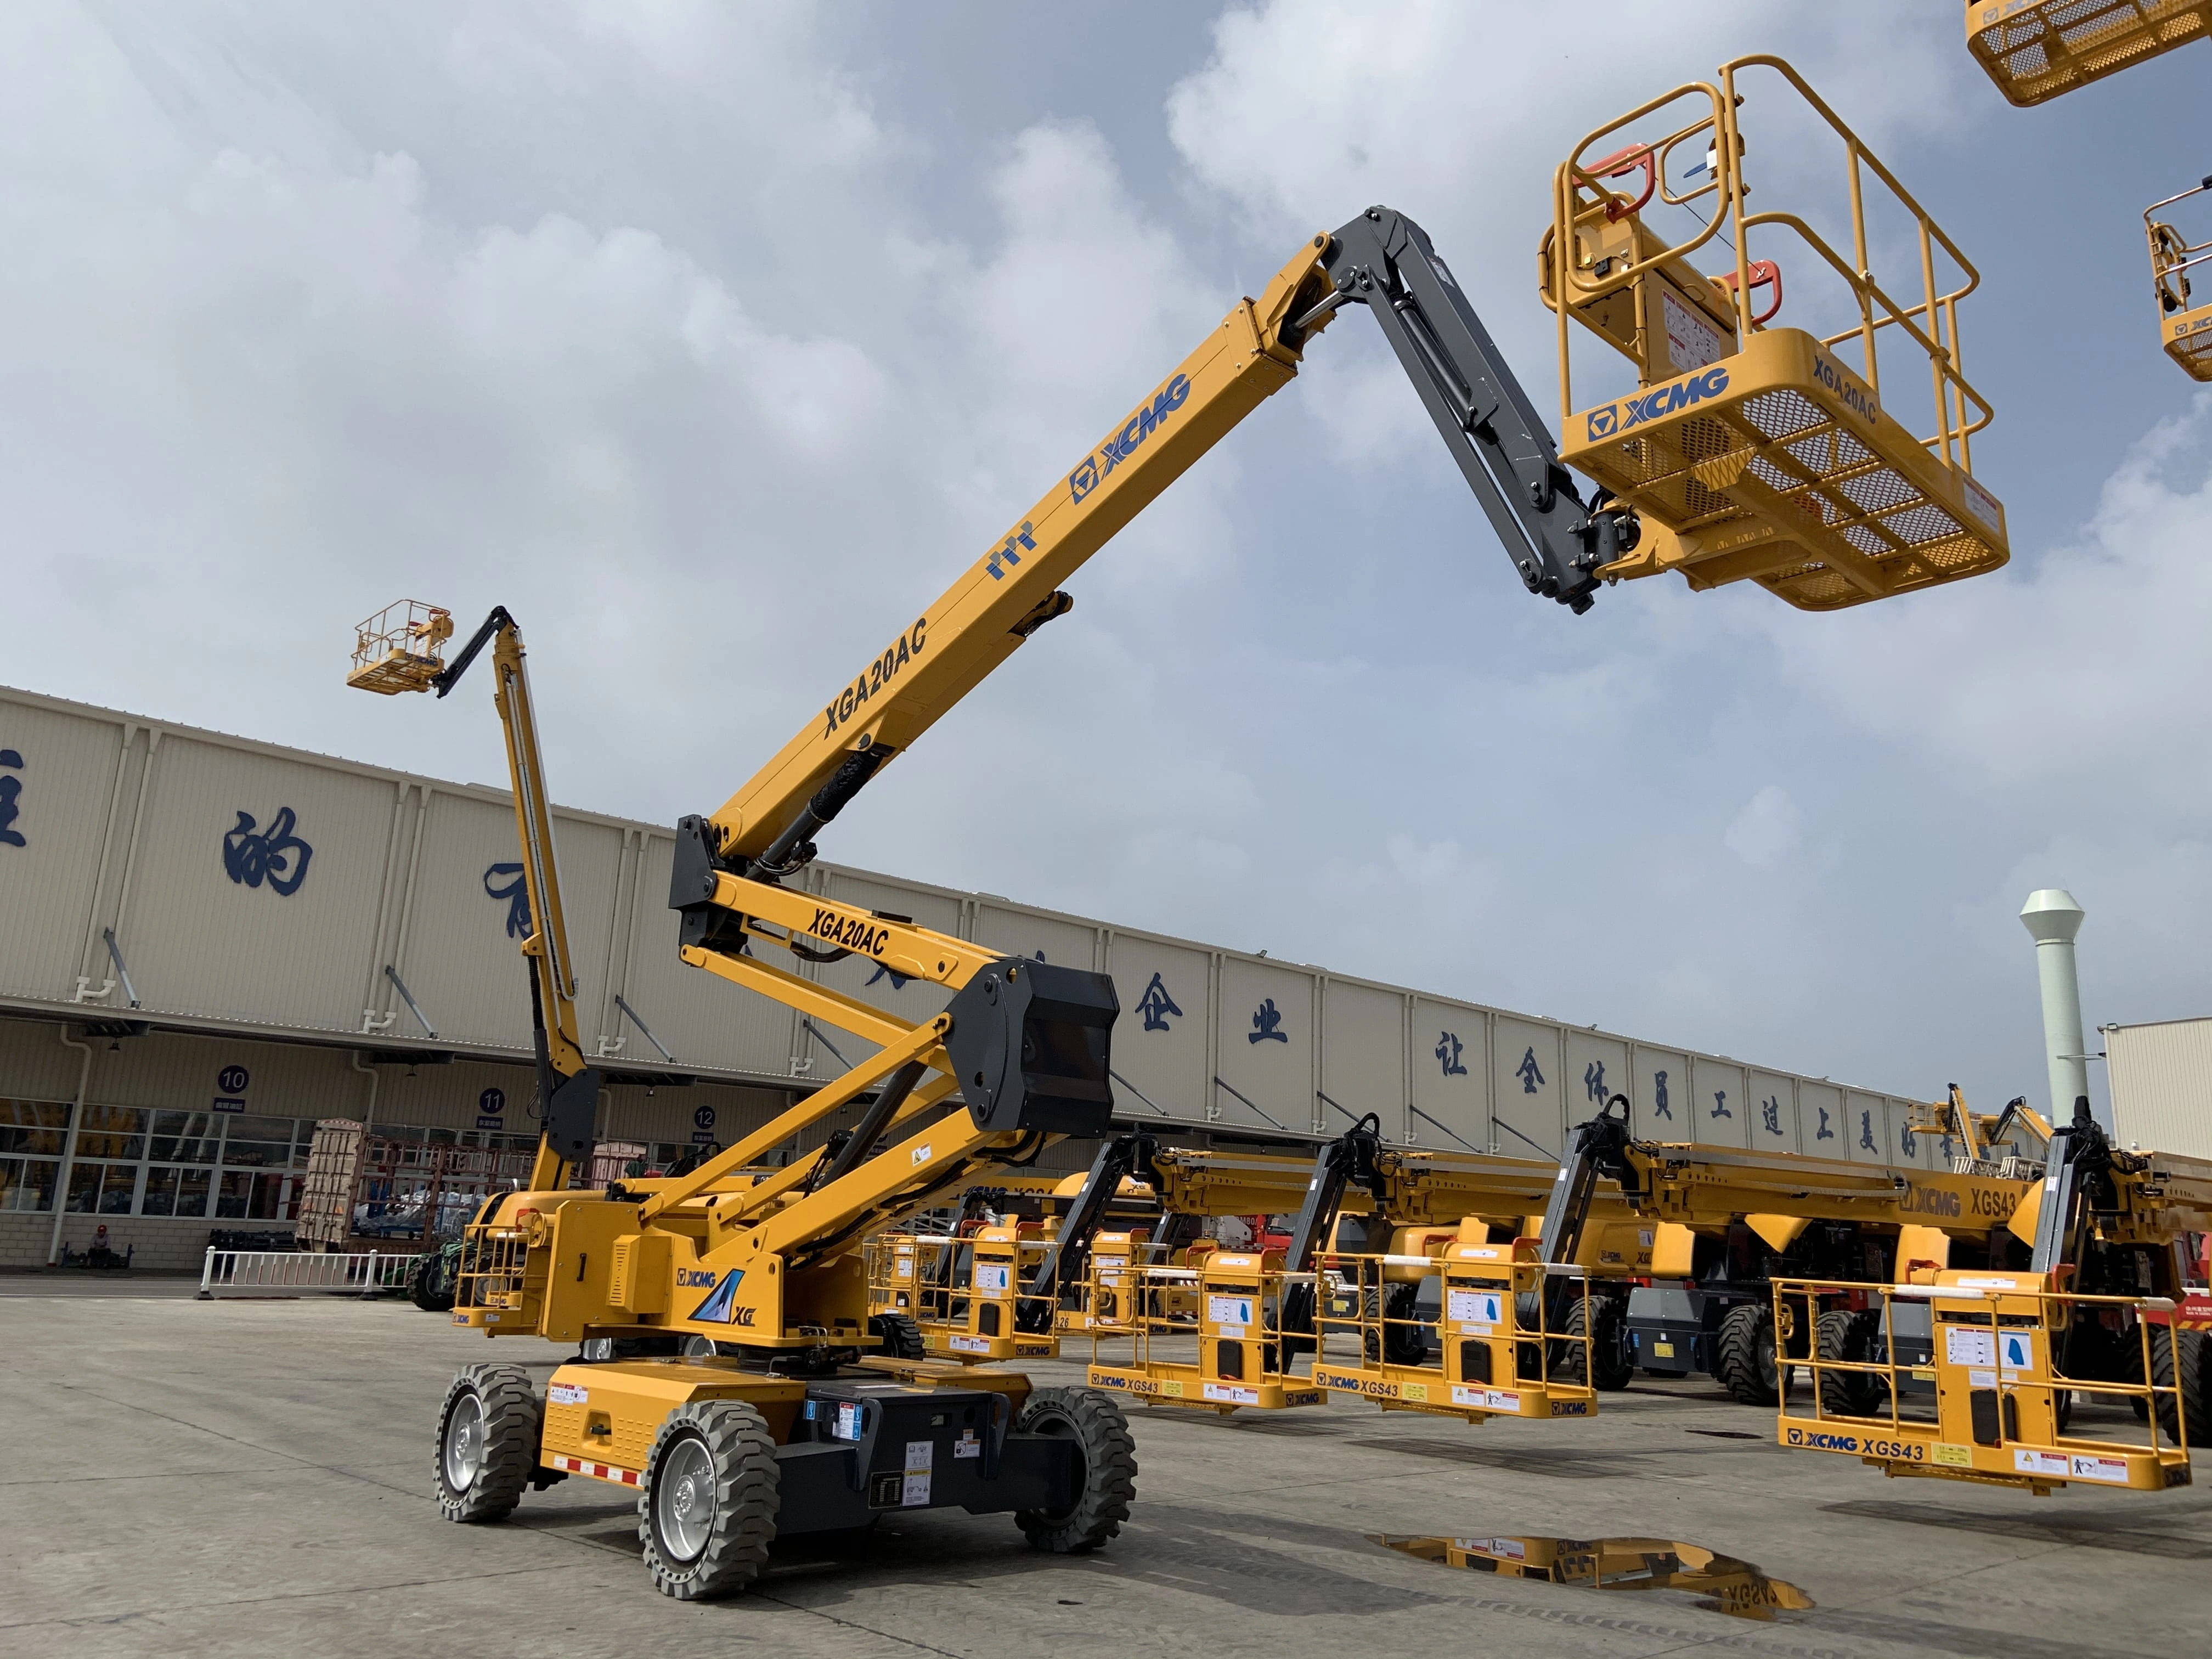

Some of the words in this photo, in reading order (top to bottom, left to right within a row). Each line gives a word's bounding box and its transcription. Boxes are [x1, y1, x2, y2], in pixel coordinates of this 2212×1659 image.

[1619, 368, 1729, 429] XCMG
[1813, 354, 1877, 426] XGA20AC
[1101, 374, 1190, 480] XCMG
[825, 618, 927, 739] XGA20AC
[808, 908, 889, 956] XGA20AC
[223, 1071, 245, 1088] 10
[485, 1093, 500, 1108] 11
[698, 1111, 713, 1125] 12
[1914, 1187, 1961, 1217] XCMG
[1971, 1188, 2016, 1217] XGS43
[685, 1271, 716, 1288] XCMG
[731, 1306, 757, 1327] XG
[1025, 1346, 1050, 1356] XCMG
[1099, 1375, 1126, 1387] XCMG
[1127, 1379, 1158, 1393] XGS43
[1327, 1375, 1359, 1390] XCMG
[1360, 1380, 1398, 1397] XGS43
[1294, 1392, 1319, 1406] XCMG
[1561, 1402, 1587, 1415] XCMG
[1804, 1432, 1858, 1451] XCMG
[1861, 1438, 1923, 1460] XGS43
